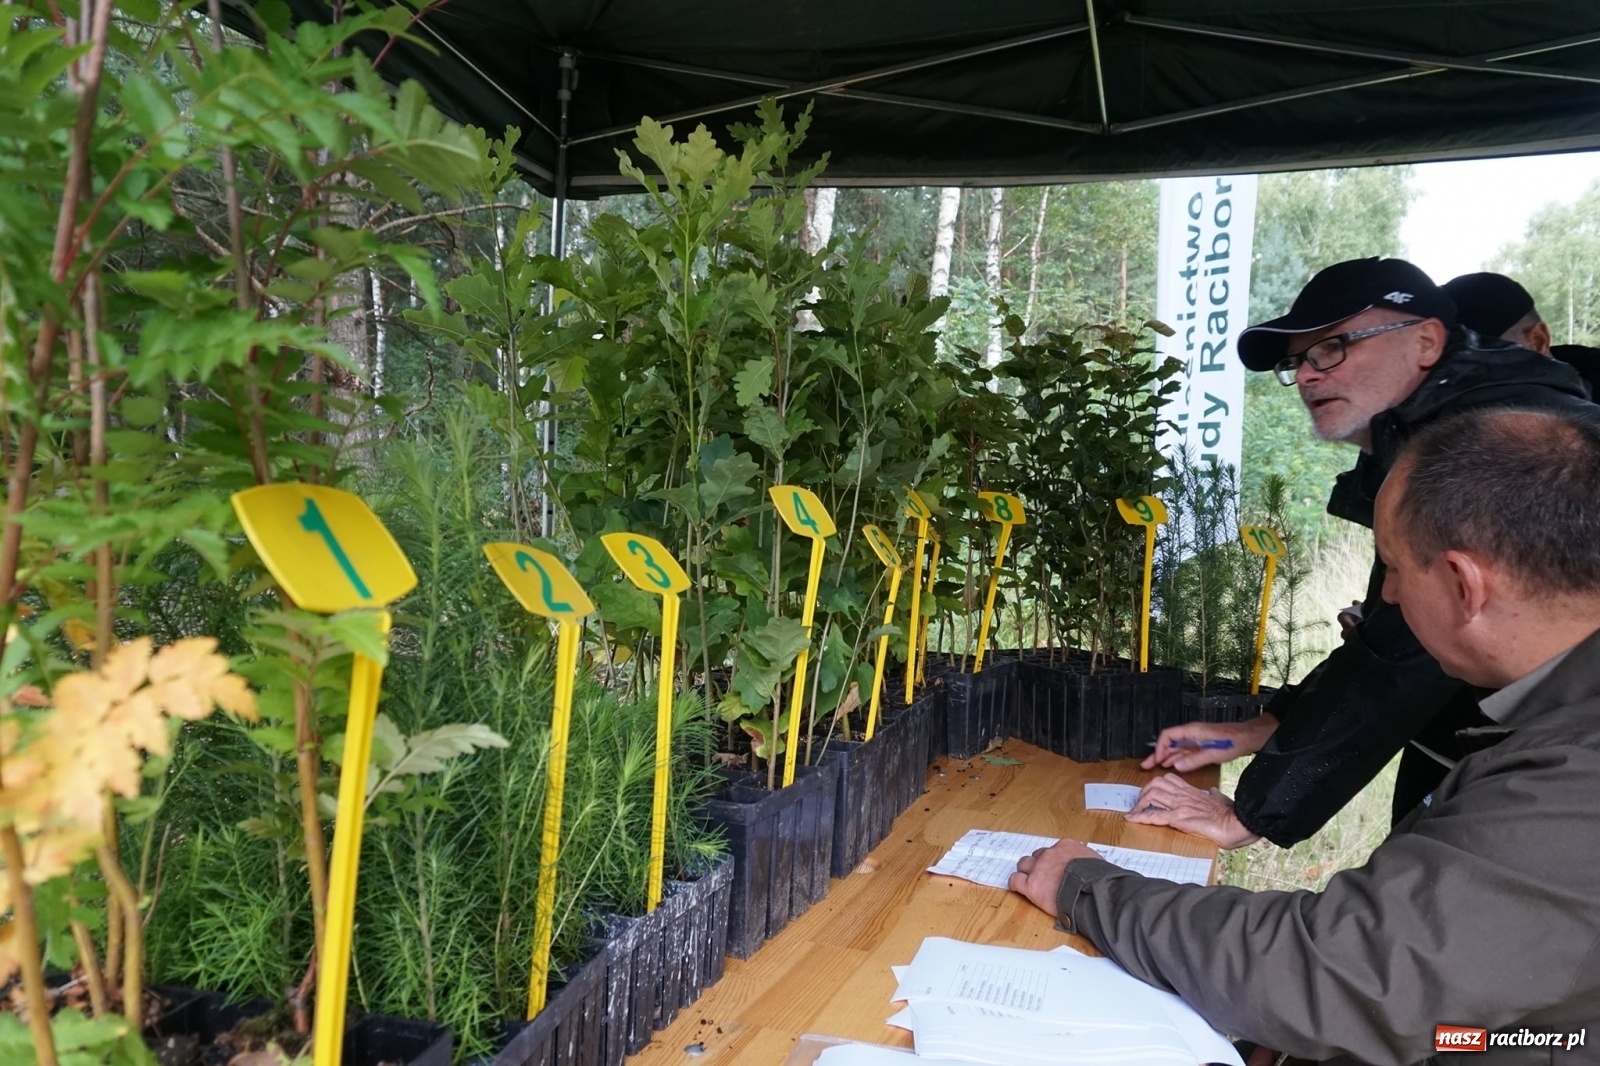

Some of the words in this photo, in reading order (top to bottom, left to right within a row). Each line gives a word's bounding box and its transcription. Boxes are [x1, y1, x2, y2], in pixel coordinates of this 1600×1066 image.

[1200, 177, 1232, 373] Racibor
[1198, 391, 1229, 500] udy
[793, 491, 820, 534] 4
[994, 495, 1013, 522] 8
[1133, 499, 1154, 523] 9
[297, 497, 373, 599] 1
[870, 529, 897, 565] 5
[1248, 528, 1278, 553] 10
[514, 550, 574, 612] 2
[627, 539, 671, 589] 3
